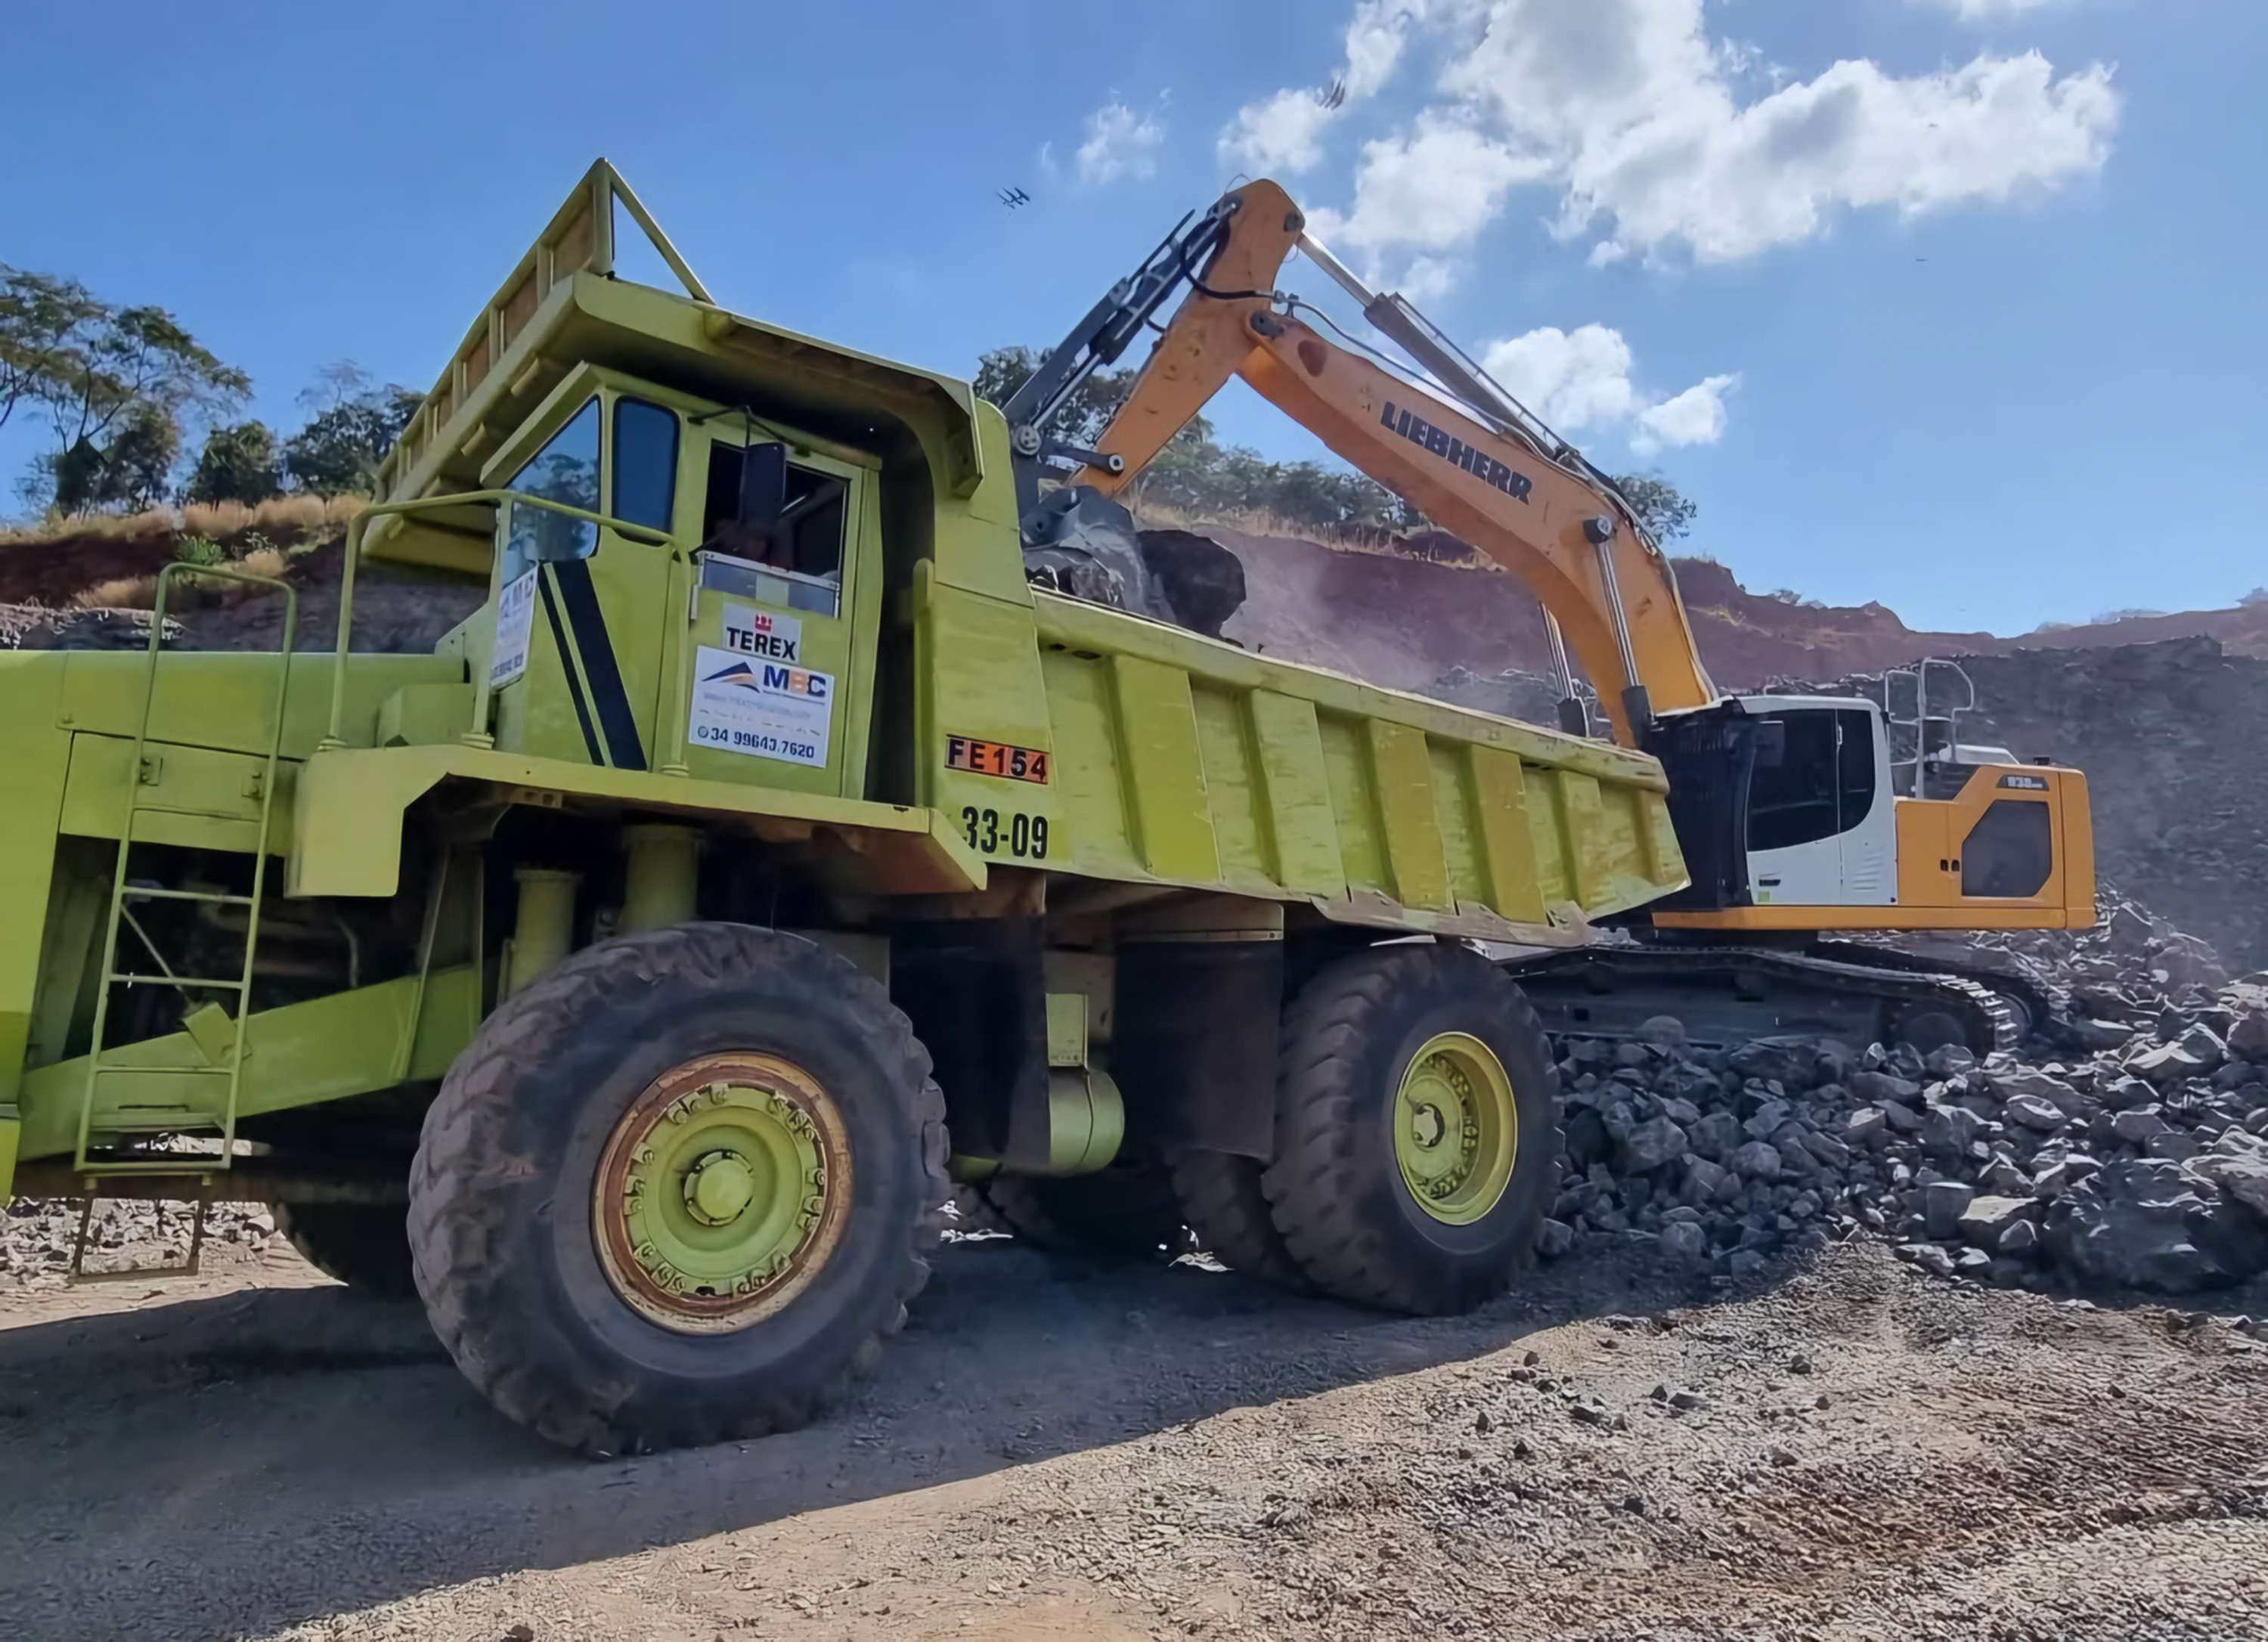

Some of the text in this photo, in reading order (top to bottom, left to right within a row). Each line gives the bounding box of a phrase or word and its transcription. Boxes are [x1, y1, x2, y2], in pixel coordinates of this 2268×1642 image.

[1380, 401, 1532, 505] LIEBHERR
[727, 627, 796, 660] TEREX
[763, 665, 826, 698] MBC
[711, 727, 728, 742] 34
[962, 806, 1048, 859] 33-09
